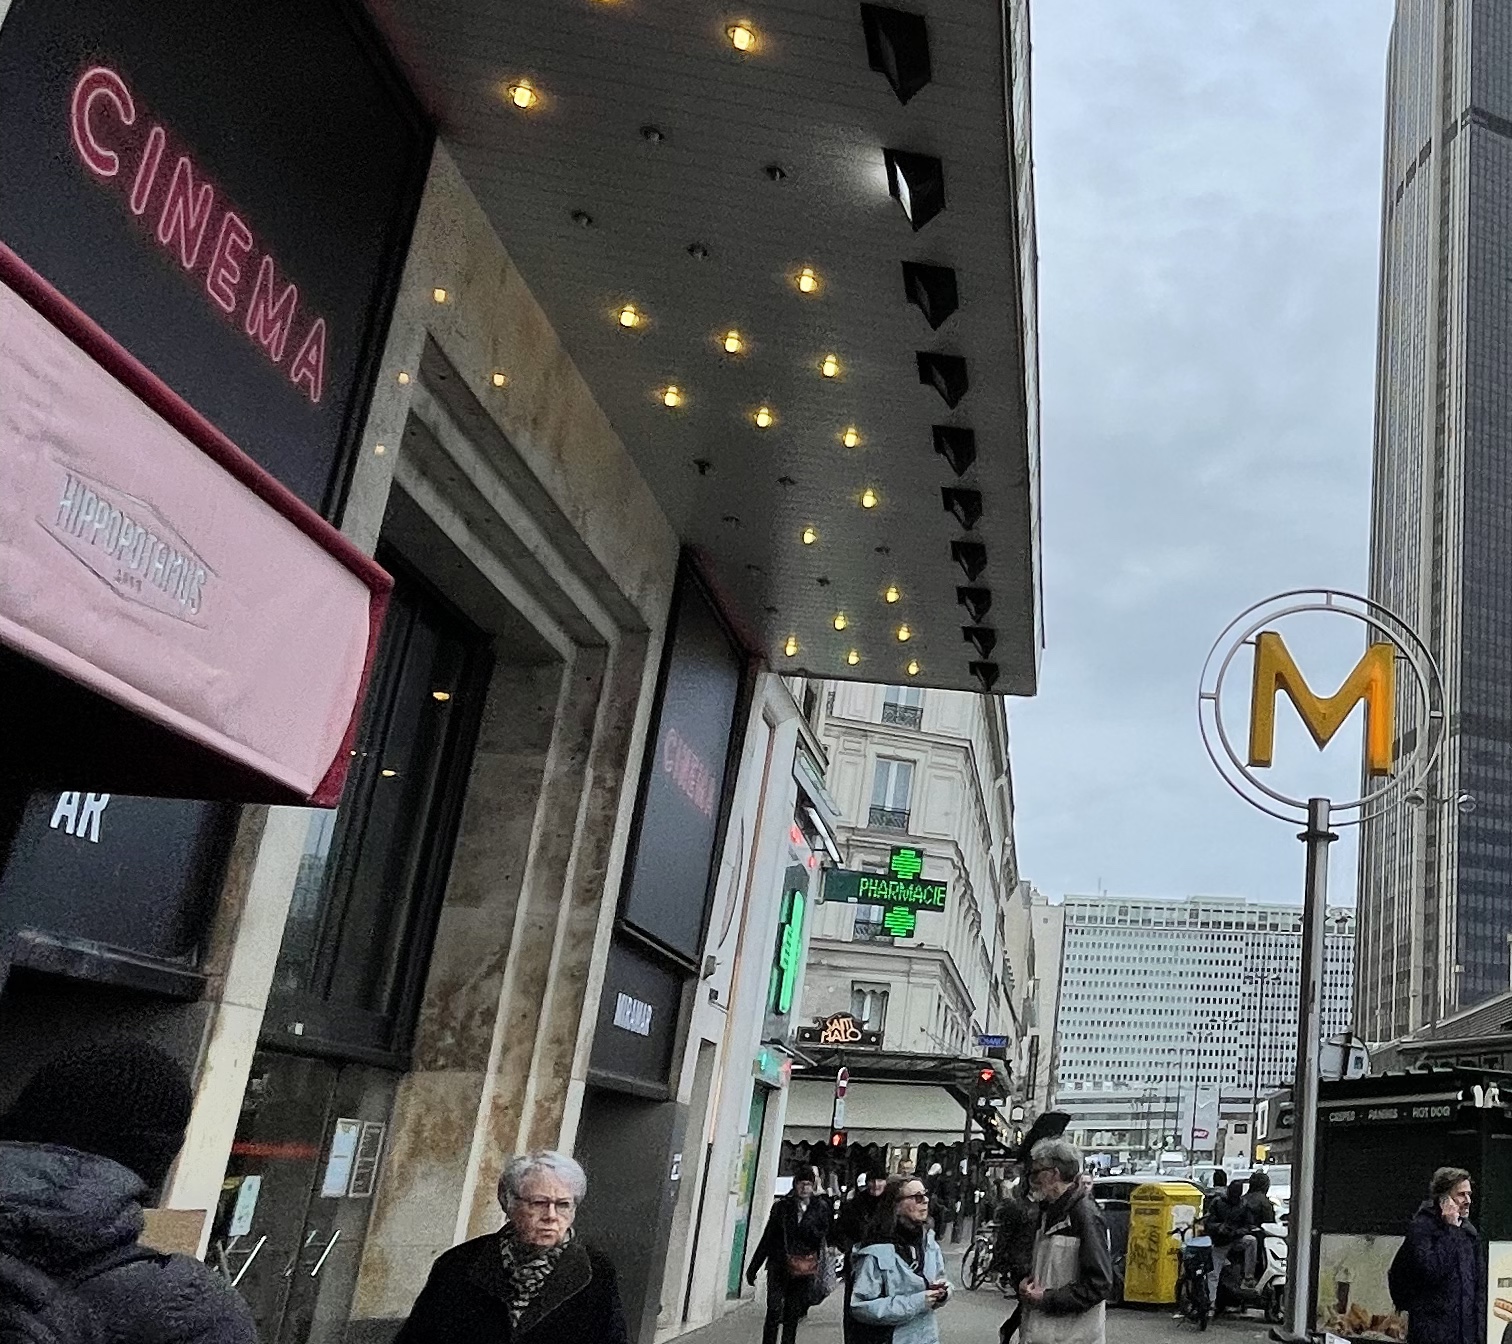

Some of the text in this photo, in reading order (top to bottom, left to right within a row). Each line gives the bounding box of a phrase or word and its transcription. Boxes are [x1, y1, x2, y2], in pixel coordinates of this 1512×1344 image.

[72, 67, 326, 402] CINEMA
[56, 473, 207, 615] HIPPOPOTAMUS
[1249, 630, 1394, 776] M
[663, 728, 716, 820] CINEMA
[859, 877, 946, 907] PHARMACIE
[820, 1028, 862, 1044] MALO
[1412, 1107, 1429, 1119] HOT
[1430, 1106, 1451, 1118] DOG
